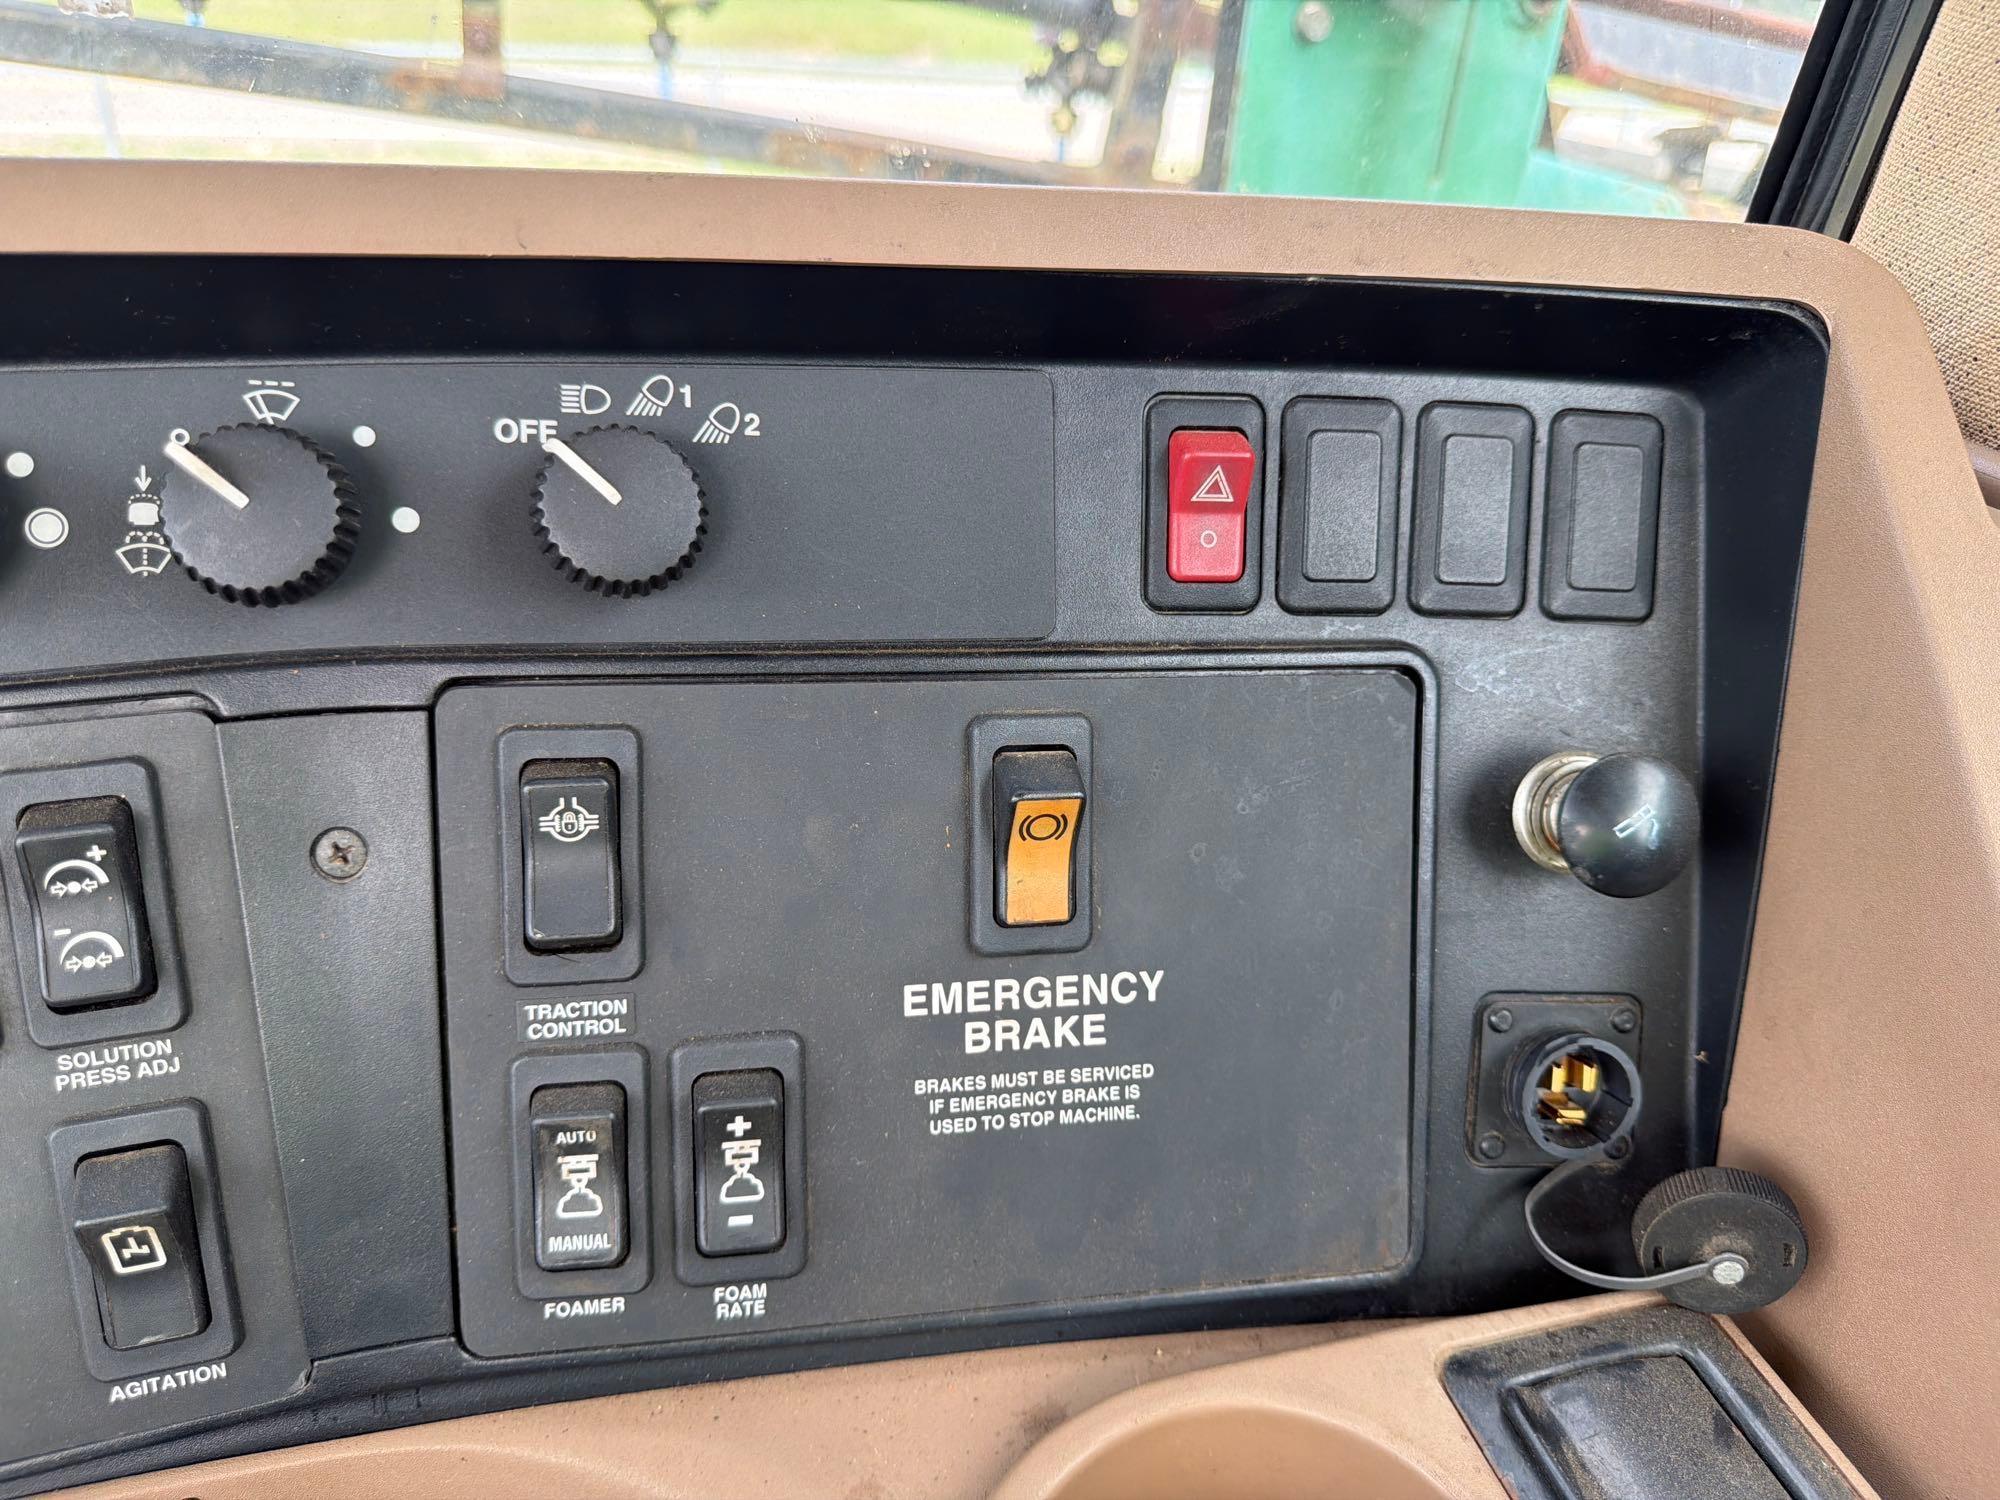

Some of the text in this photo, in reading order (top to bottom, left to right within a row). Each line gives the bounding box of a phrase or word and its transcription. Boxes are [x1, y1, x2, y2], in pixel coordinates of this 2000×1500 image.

[679, 384, 692, 408] 1
[494, 418, 558, 444] OFF
[744, 413, 761, 436] 2
[903, 970, 1164, 1017] EMERGENCY
[524, 999, 628, 1021] TRACTION
[527, 1018, 627, 1040] CONTROL
[965, 1013, 1107, 1054] BRAKE
[57, 1039, 173, 1071] SOLUTION
[55, 1057, 180, 1091] PRESS ADJ
[914, 1063, 1154, 1095] BRAKES MUST BE SERVICED
[929, 1084, 1140, 1114] IF EMERGENCY BRAKE IS
[929, 1105, 1140, 1135] USED TO STOP MACHINE.
[556, 1130, 597, 1145] AUTO
[549, 1233, 611, 1252] MANUAL
[713, 1283, 767, 1304] FOAM
[544, 1297, 625, 1319] FOAMER
[716, 1299, 765, 1320] RATE
[110, 1362, 227, 1402] AGITATION
